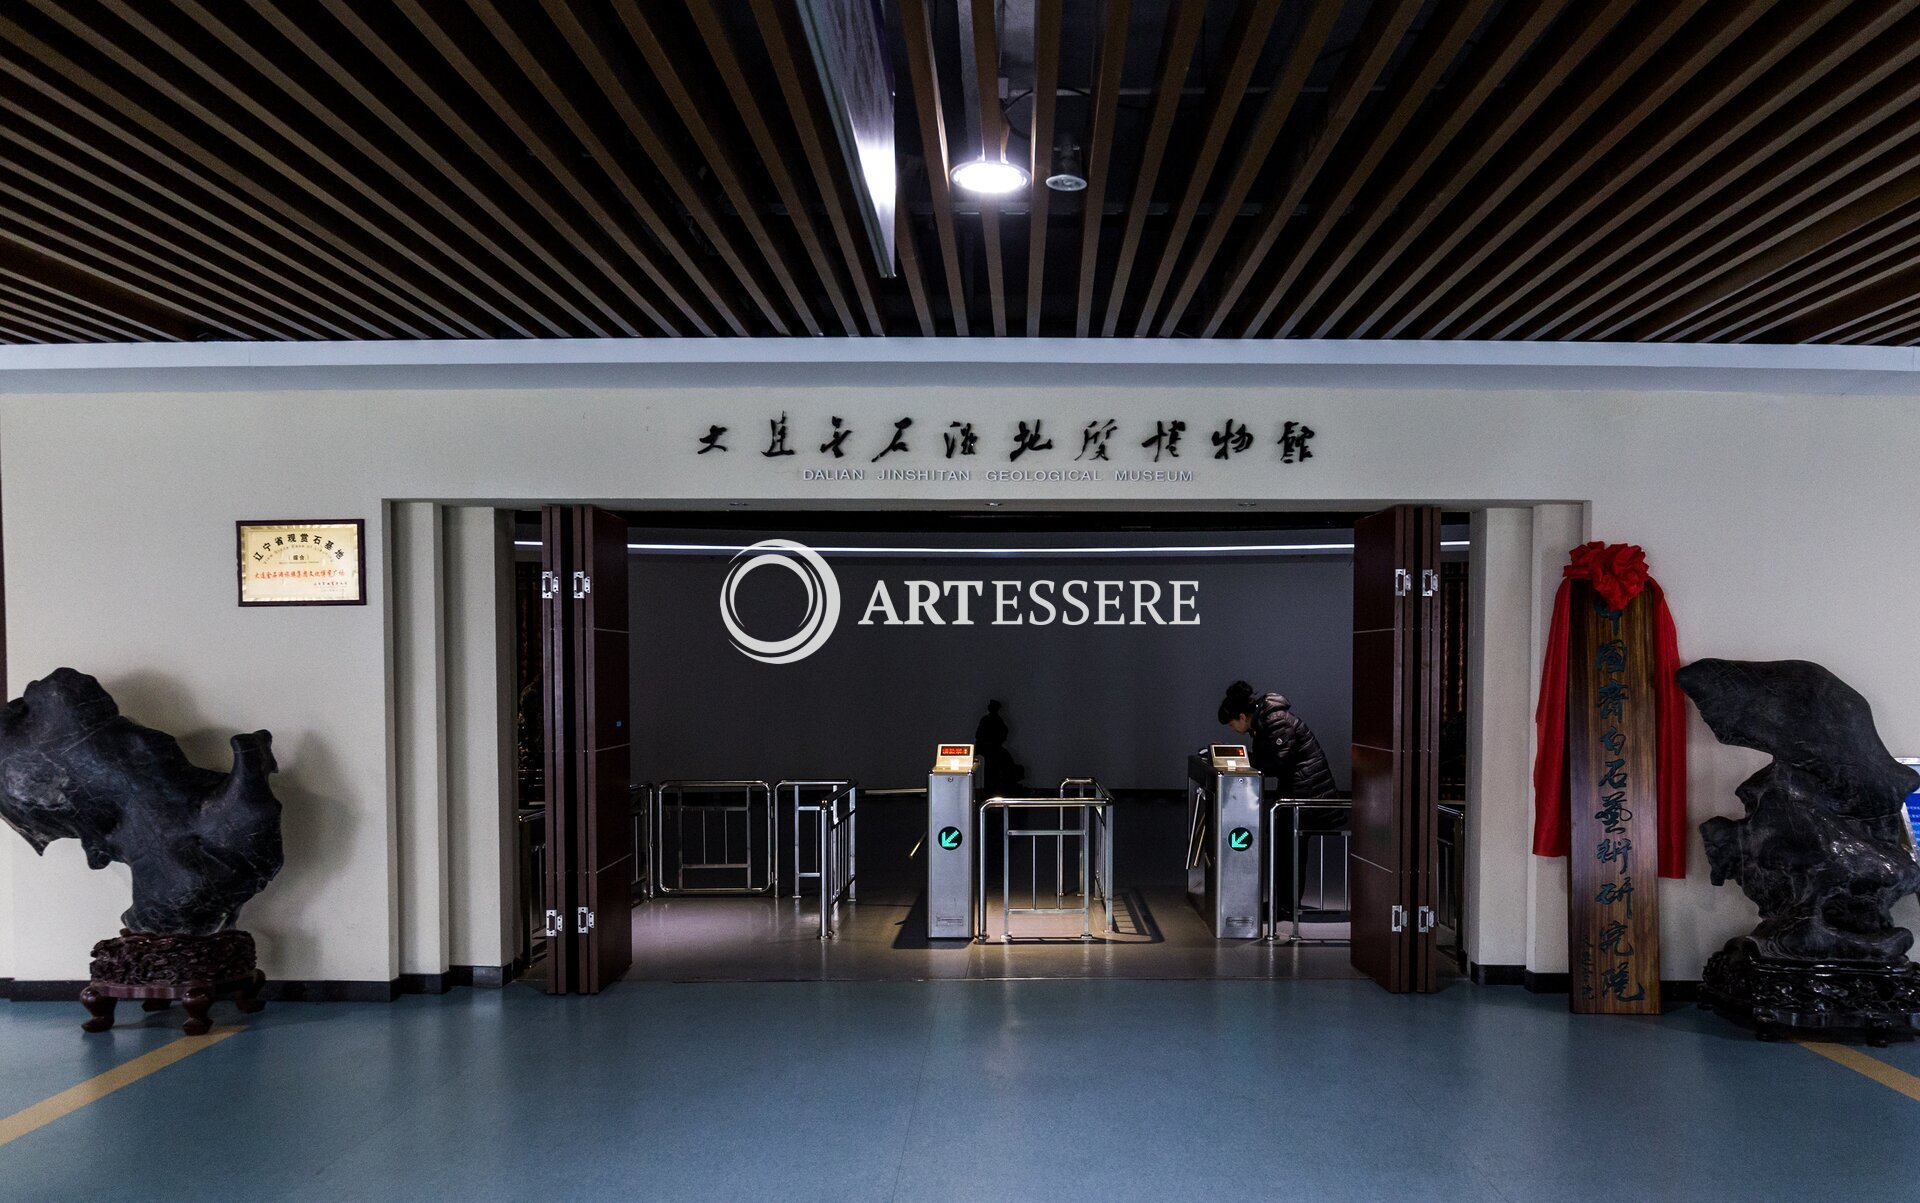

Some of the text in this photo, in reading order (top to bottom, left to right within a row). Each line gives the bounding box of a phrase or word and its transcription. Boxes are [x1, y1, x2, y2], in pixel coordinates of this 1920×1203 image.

[803, 469, 1194, 482] DALIAN JINSHITAN GEOLOGICAL MUSEUM
[253, 533, 345, 562] 辽宁省观赏石基地
